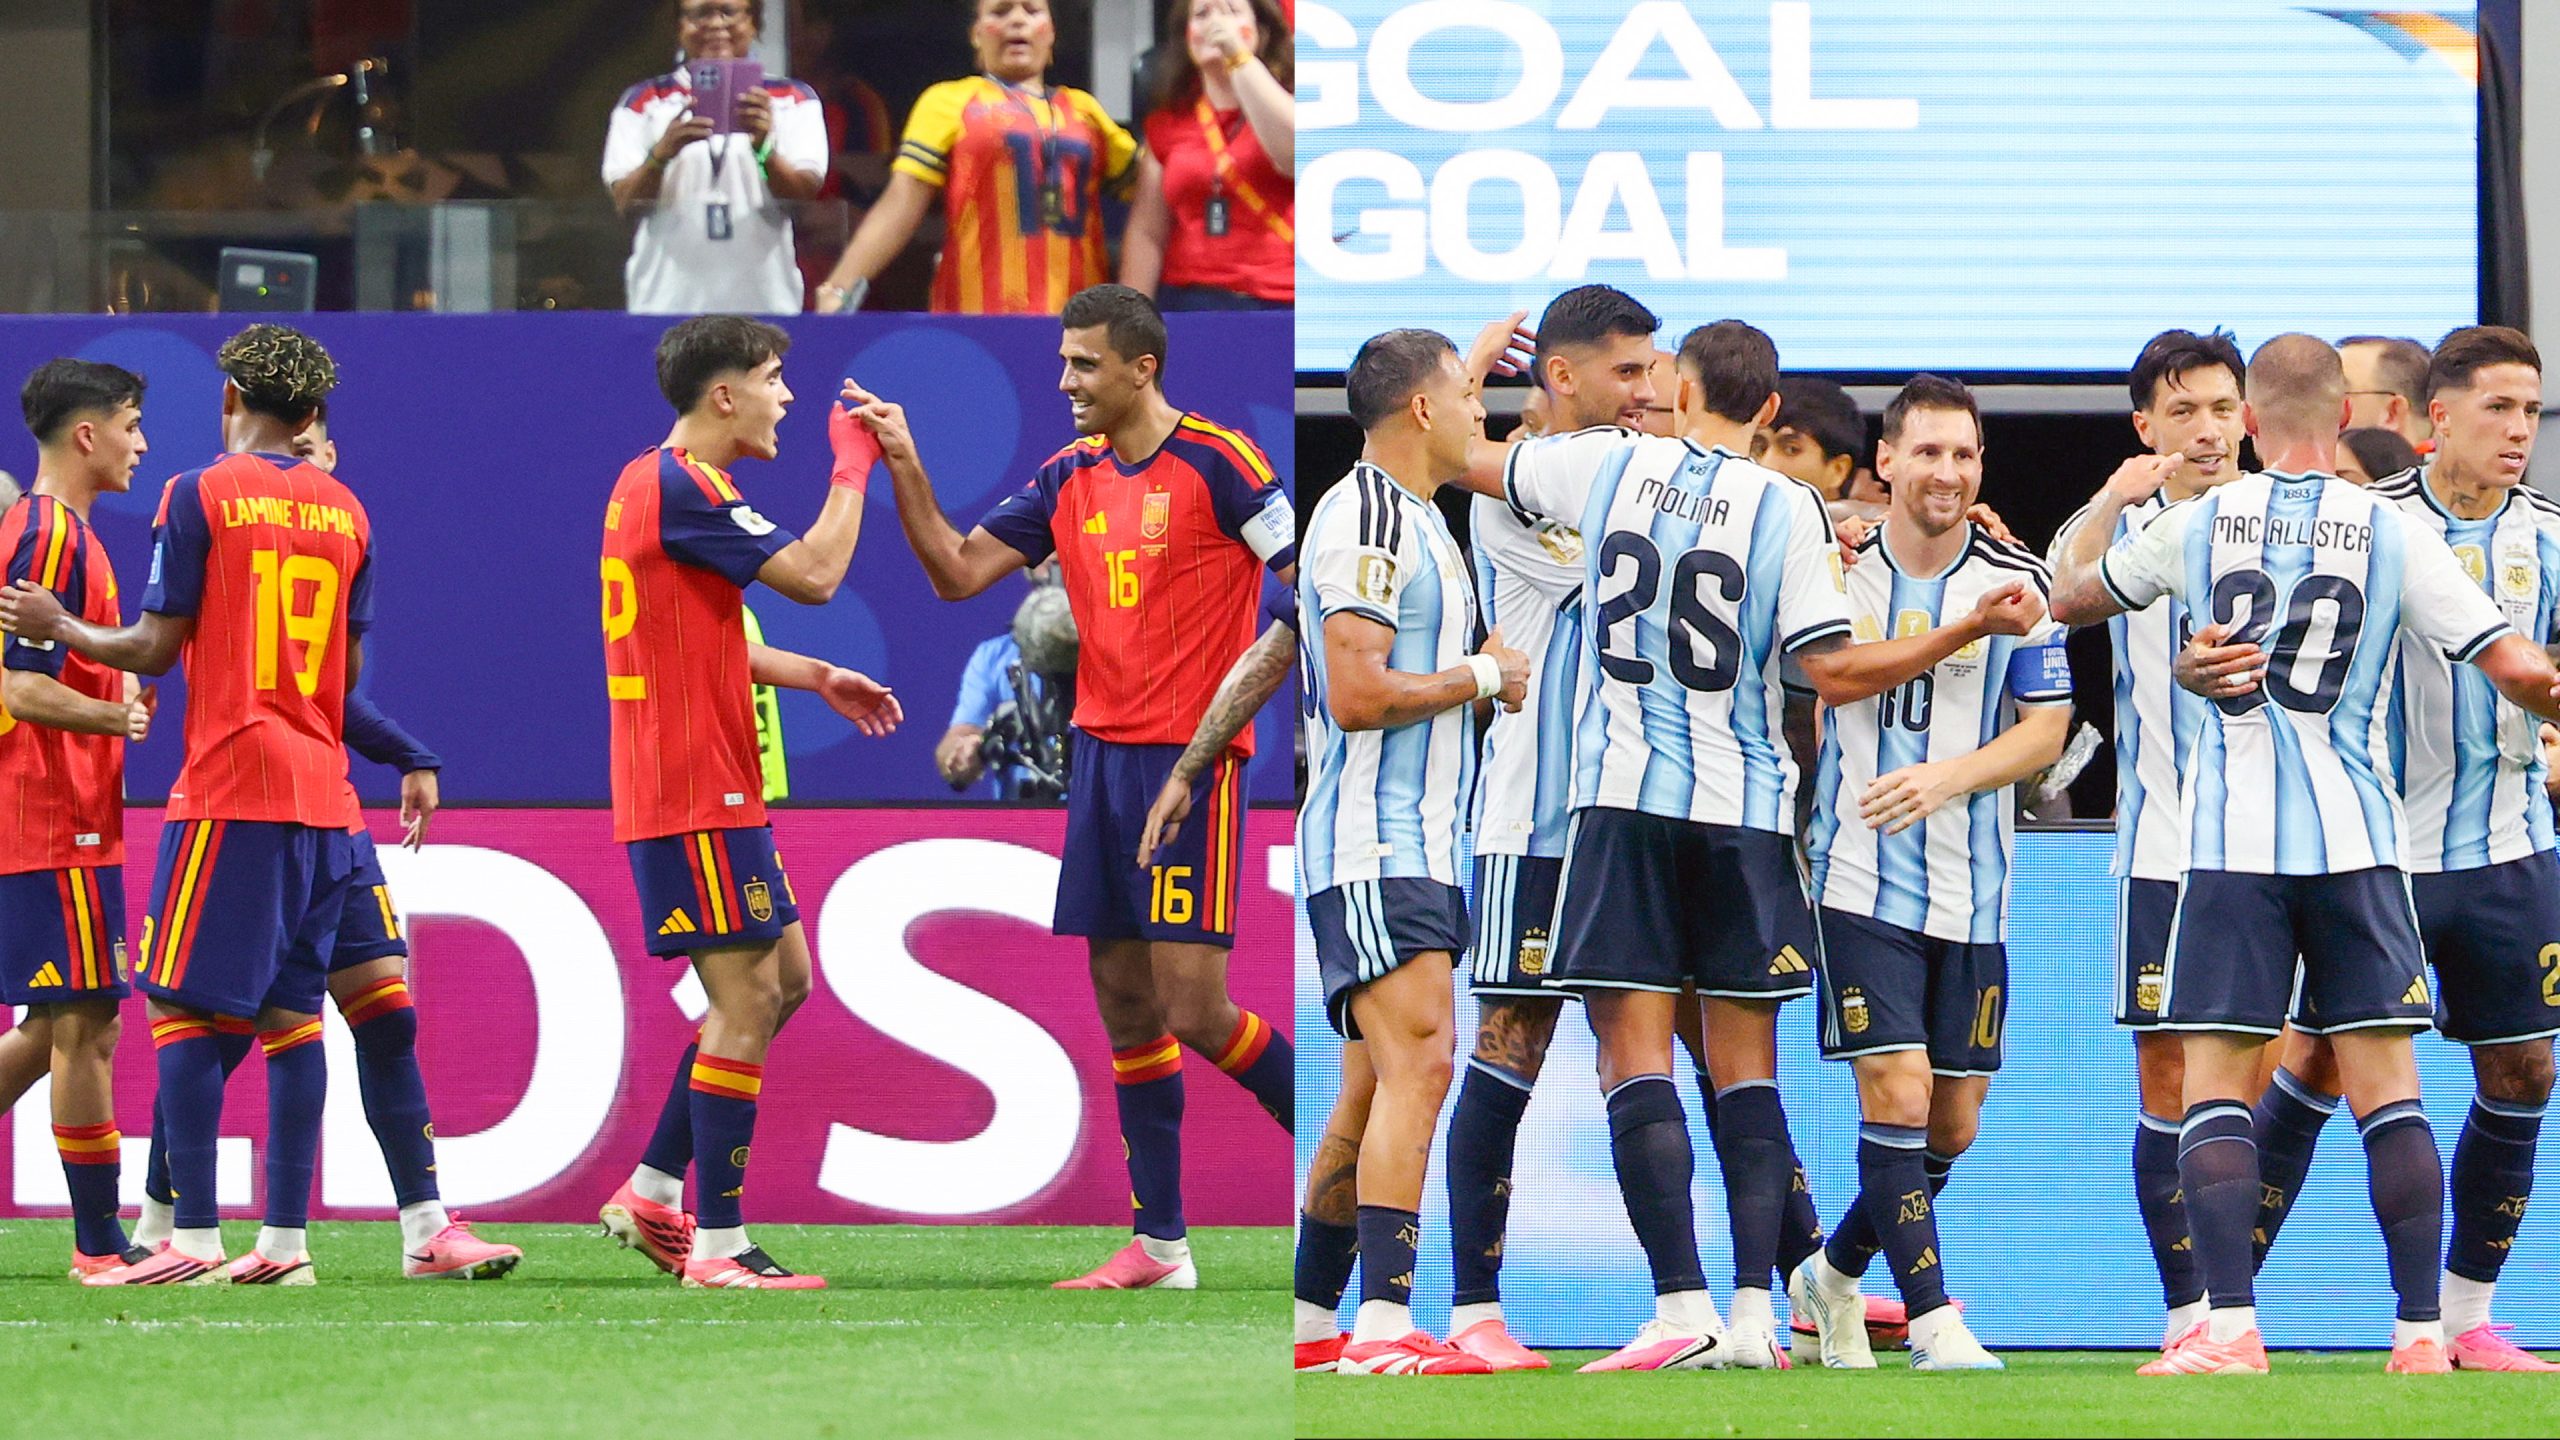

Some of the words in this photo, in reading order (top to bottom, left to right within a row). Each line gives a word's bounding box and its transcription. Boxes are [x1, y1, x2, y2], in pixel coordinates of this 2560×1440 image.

[1005, 132, 1093, 237] 10
[1297, 148, 1789, 281] GOAL
[221, 497, 293, 528] LAMINE
[297, 501, 357, 540] YAMAL
[1636, 478, 1730, 526] MOLINA
[2210, 515, 2261, 545] MAC
[2268, 518, 2373, 553] ALLISTER
[1105, 549, 1139, 608] 16
[1597, 530, 1746, 692] 26
[252, 550, 340, 697] 19
[601, 557, 647, 700] 2
[2212, 568, 2366, 717] 20
[1149, 865, 1193, 925] 16
[1968, 985, 2000, 1050] 10
